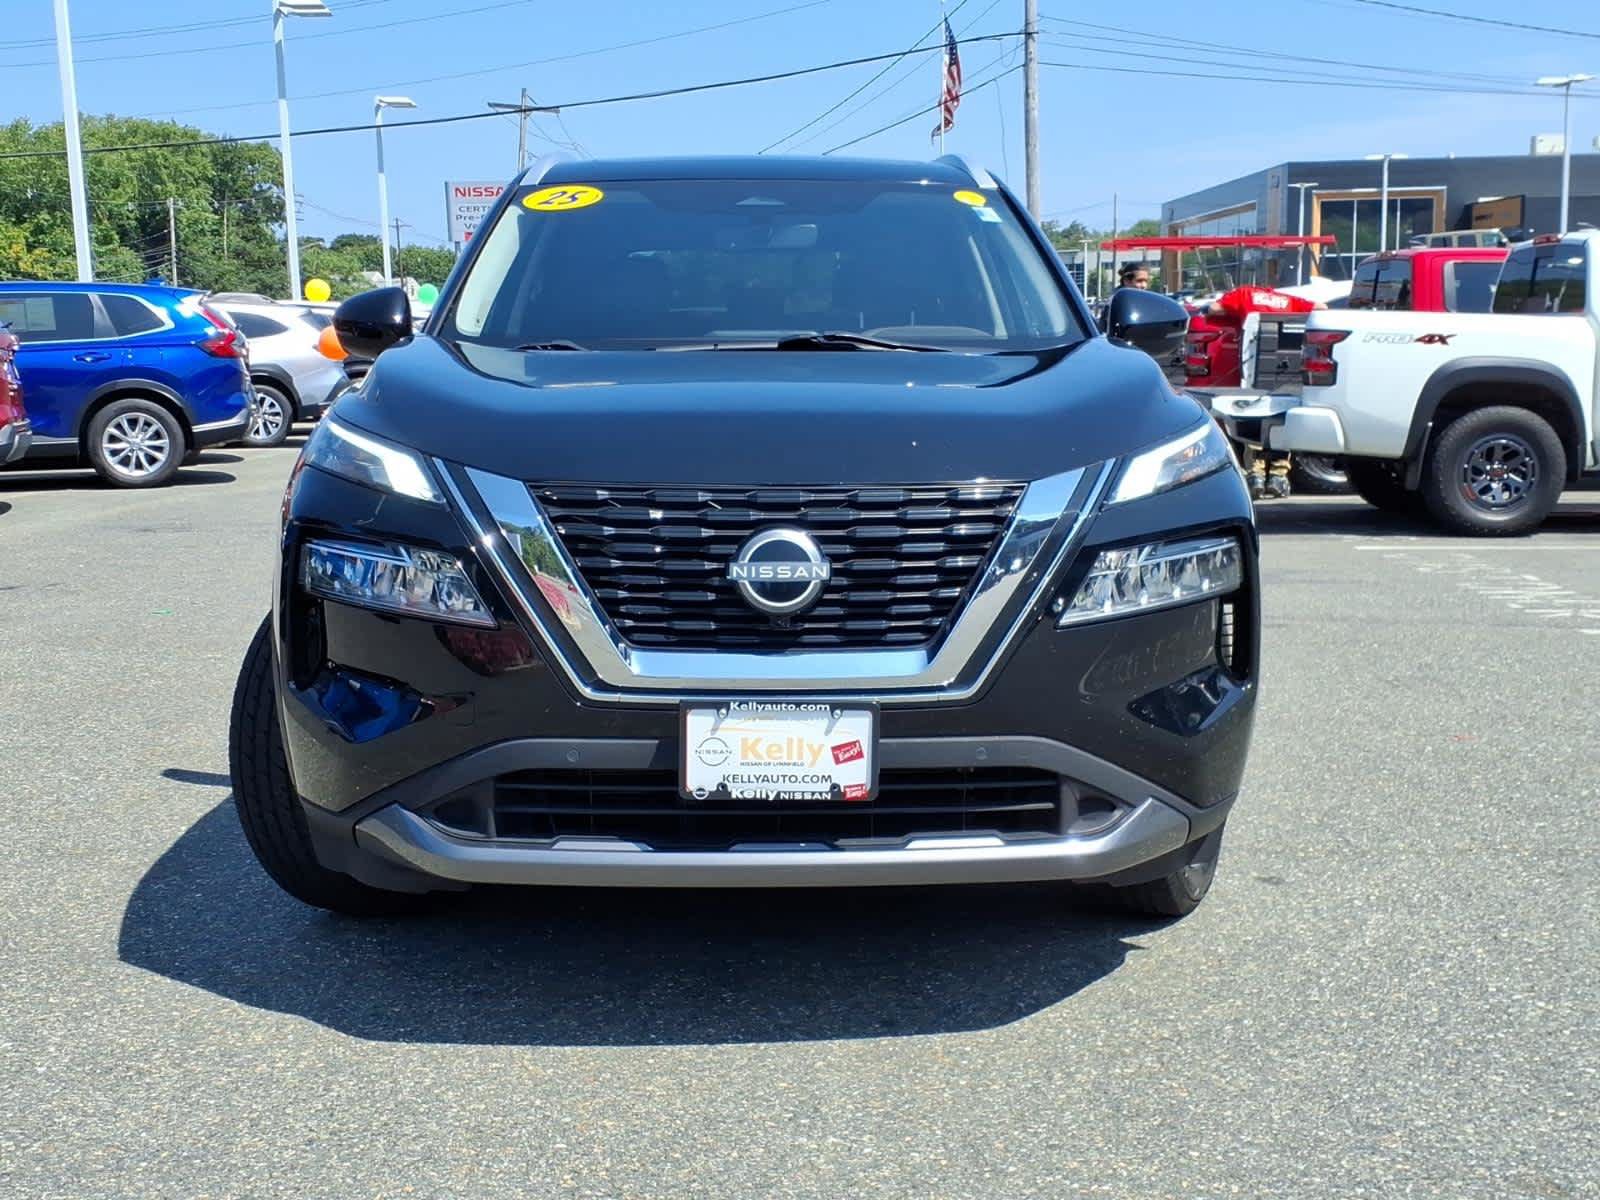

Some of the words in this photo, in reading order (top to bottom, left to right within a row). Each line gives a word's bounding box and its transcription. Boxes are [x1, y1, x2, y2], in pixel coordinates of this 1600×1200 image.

[538, 190, 590, 206] 25
[732, 565, 827, 578] NISSAN
[729, 701, 831, 712] Kellyauto.com
[740, 736, 825, 768] Kelly
[722, 774, 832, 784] KELLYAUTO.COM
[731, 788, 777, 800] Kelly
[779, 792, 832, 800] NISSAN
